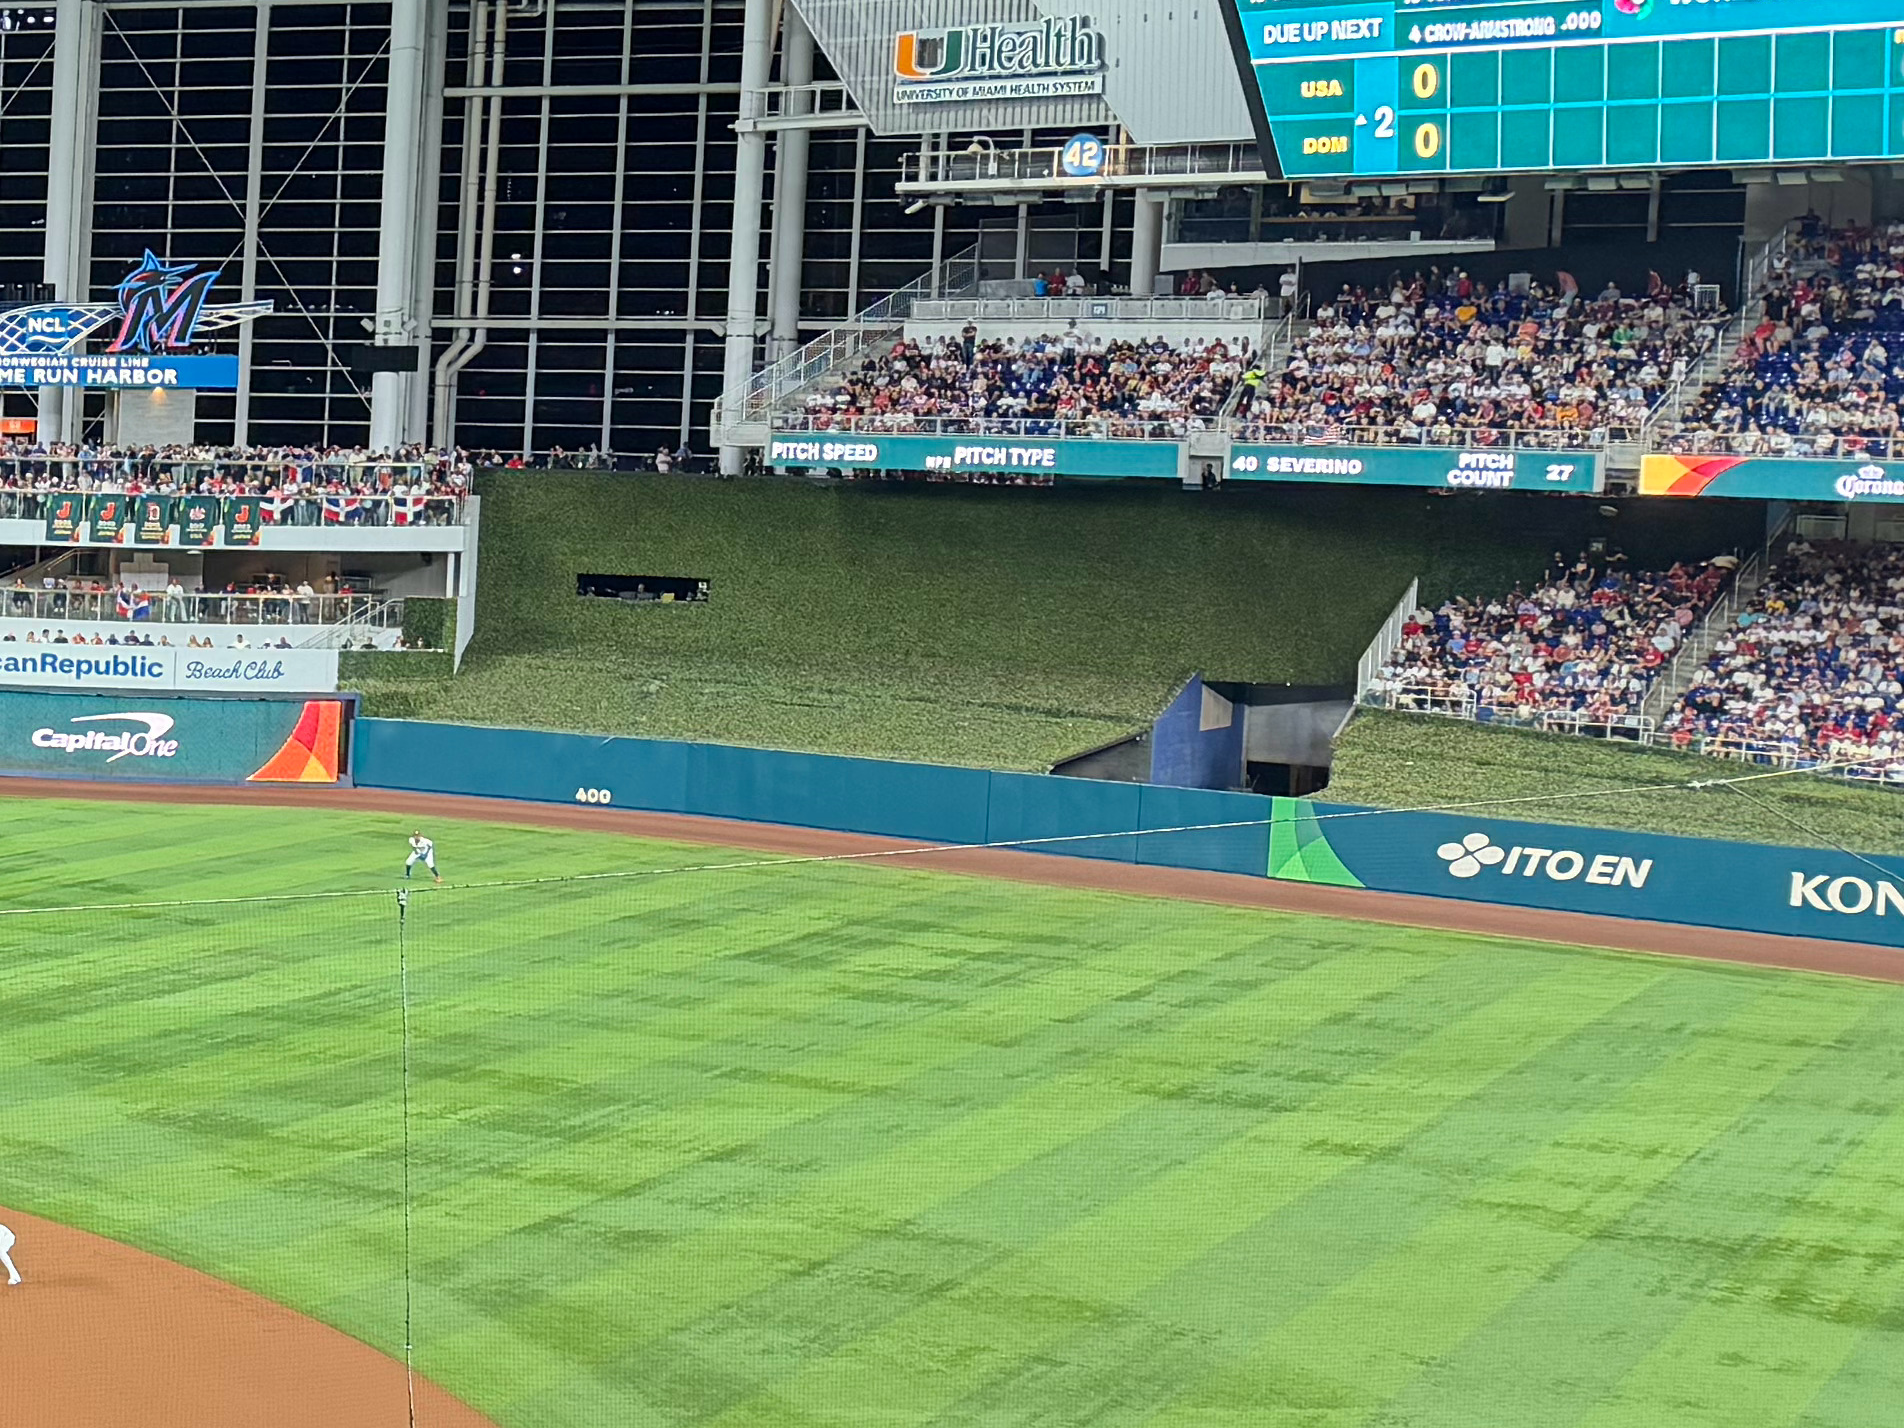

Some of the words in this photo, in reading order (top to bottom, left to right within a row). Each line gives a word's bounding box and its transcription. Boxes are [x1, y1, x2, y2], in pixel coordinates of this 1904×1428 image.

[1264, 23, 1301, 44] DUE
[1303, 21, 1328, 41] UP
[1332, 17, 1383, 39] NEXT
[1425, 16, 1555, 43] CROW-ARMSTRONG
[897, 87, 955, 102] UNIVERSITY
[956, 86, 969, 99] OF
[972, 84, 1007, 98] MIAMI
[1009, 82, 1050, 96] HEALTH
[1051, 80, 1095, 94] SYSTEM
[1301, 79, 1342, 98] USA
[1414, 63, 1437, 99] 0
[1303, 137, 1347, 154] DOM
[1415, 123, 1439, 158] 0
[1064, 140, 1099, 167] 42
[28, 317, 66, 333] NCL
[71, 357, 117, 367] CRUISE
[120, 357, 150, 367] LINE
[33, 368, 77, 384] RUN
[86, 368, 178, 385] HARBOR
[771, 442, 820, 461] PITCH
[822, 443, 879, 462] SPEED
[954, 447, 1007, 465] PITCH
[1010, 447, 1055, 467] TYPE
[1458, 453, 1514, 470] PITCH
[1267, 456, 1362, 474] SEVERINO
[1546, 464, 1574, 481] 27
[1447, 470, 1514, 487] COUNT
[186, 660, 241, 680] Beach
[244, 660, 284, 680] Club
[576, 788, 611, 803] 400
[1502, 846, 1584, 881] ITO
[1586, 855, 1653, 888] EN
